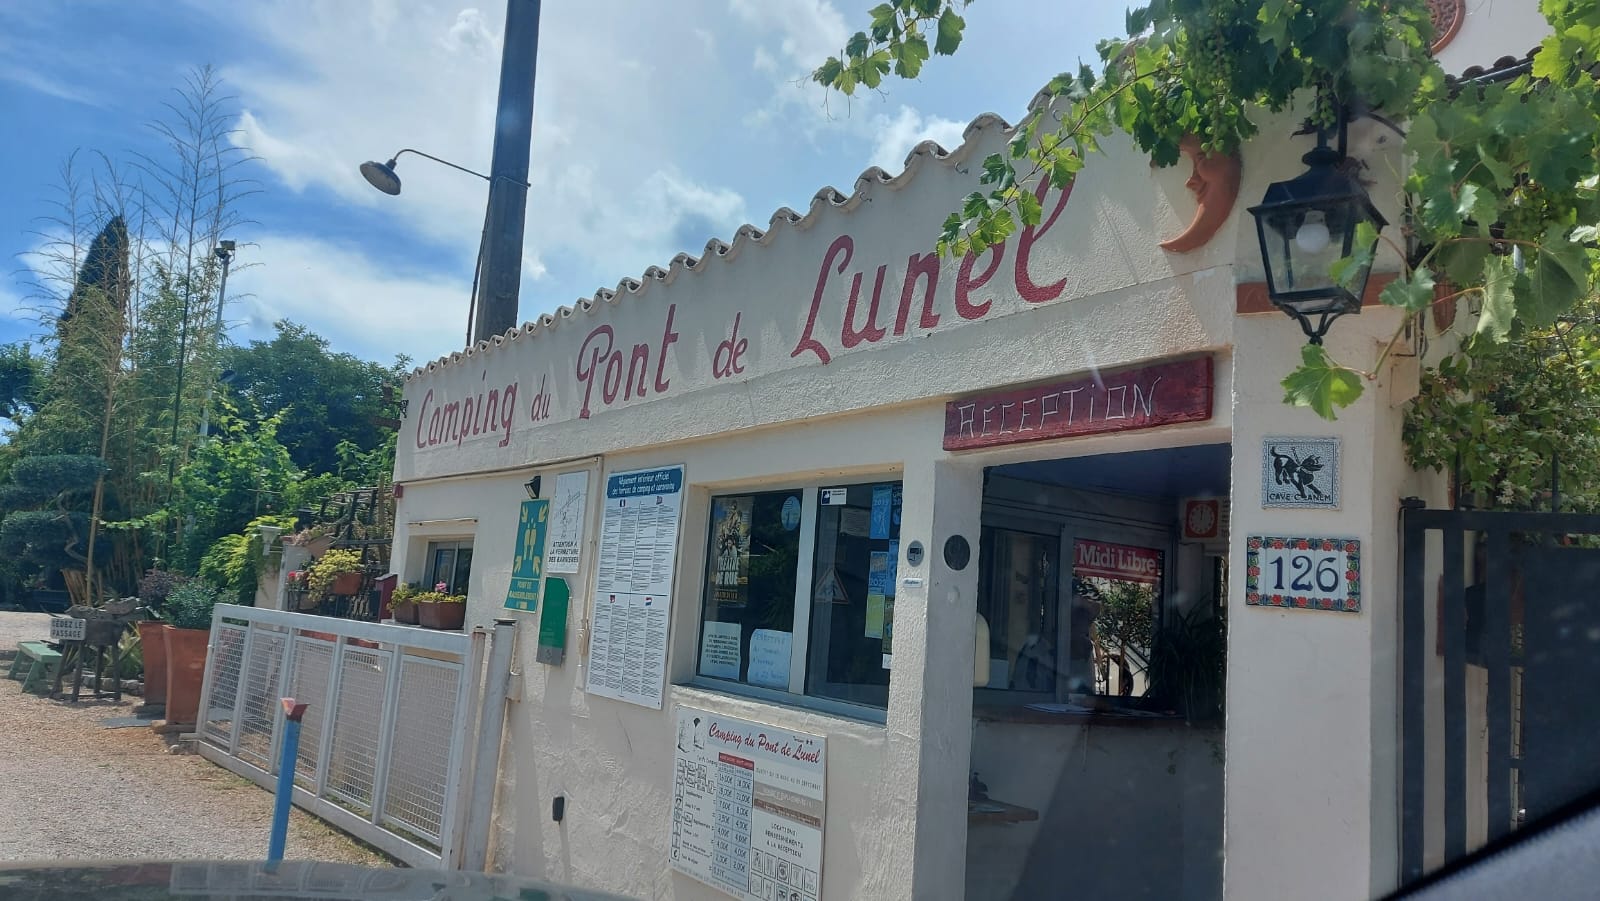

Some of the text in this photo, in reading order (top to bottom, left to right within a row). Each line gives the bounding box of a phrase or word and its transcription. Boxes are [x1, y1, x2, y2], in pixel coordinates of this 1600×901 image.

[416, 149, 1077, 449] Camping du Pont de Lunel
[1269, 493, 1291, 501] CAVE
[1079, 543, 1156, 573] Midi Libre
[1269, 555, 1339, 593] 126
[52, 629, 81, 638] PASSAGE
[709, 722, 743, 749] Camping
[744, 733, 756, 748] du
[758, 733, 778, 753] Pont
[781, 742, 791, 756] de
[793, 744, 821, 764] Lunel
